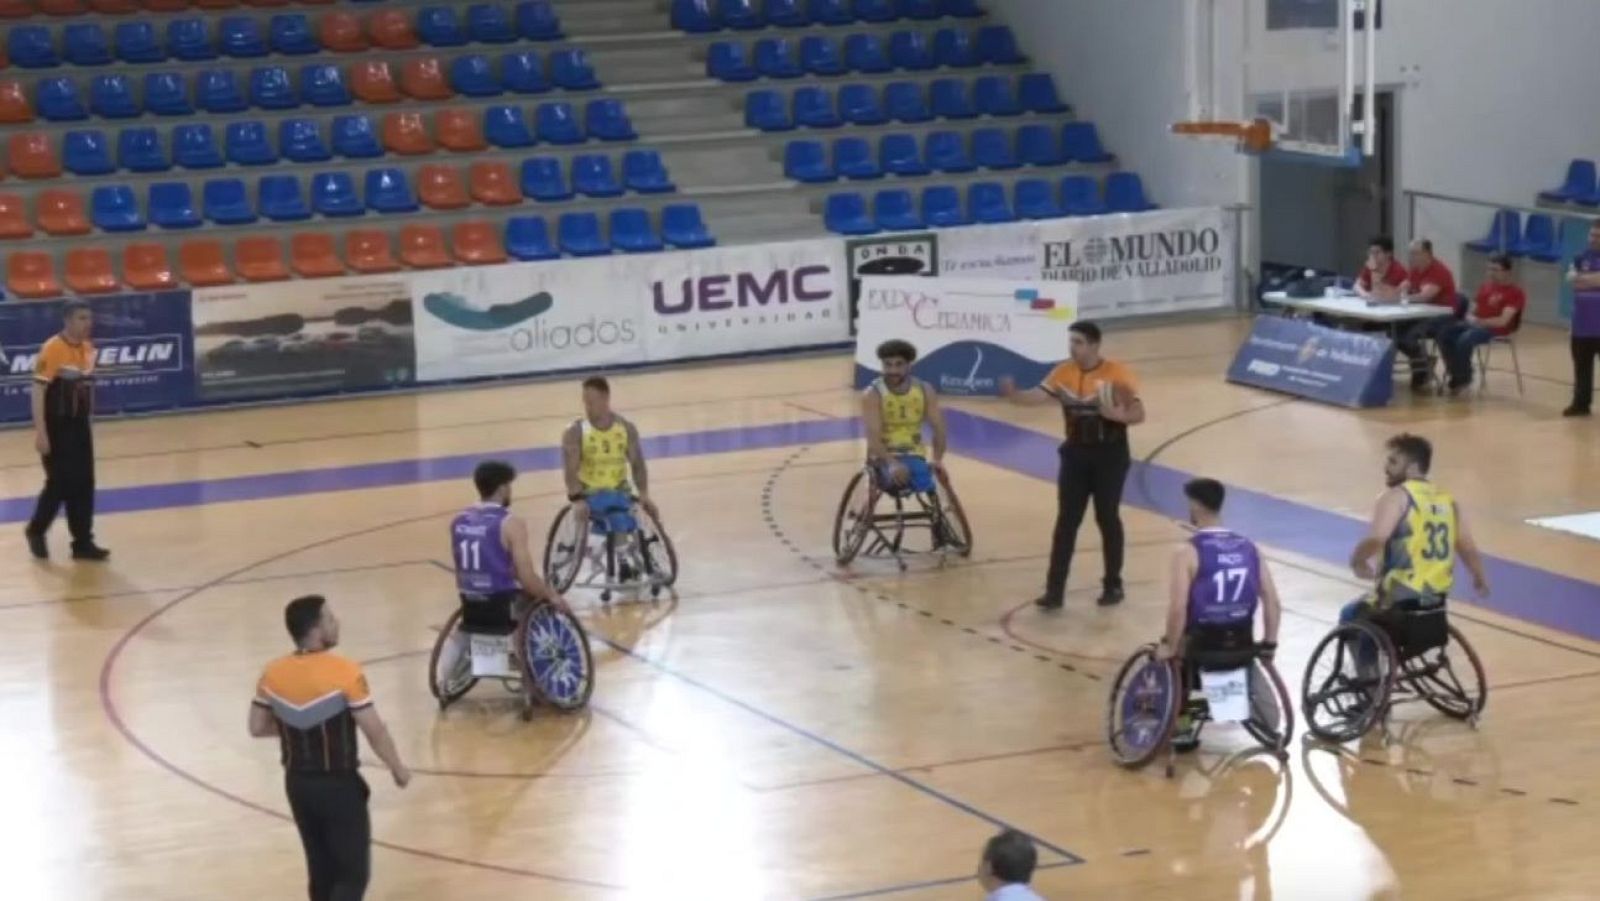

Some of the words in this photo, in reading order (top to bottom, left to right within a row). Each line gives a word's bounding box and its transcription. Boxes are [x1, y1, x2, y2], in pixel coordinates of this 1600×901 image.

[861, 244, 924, 259] ONDA
[1043, 241, 1080, 269] EL
[1109, 227, 1220, 264] MUNDO
[1125, 256, 1222, 278] VALLADOLID
[653, 265, 832, 315] UEMC
[510, 318, 635, 352] aliados
[10, 343, 173, 373] MELIN
[460, 540, 480, 570] 11
[1422, 521, 1449, 560] 33
[1212, 567, 1248, 602] 17
